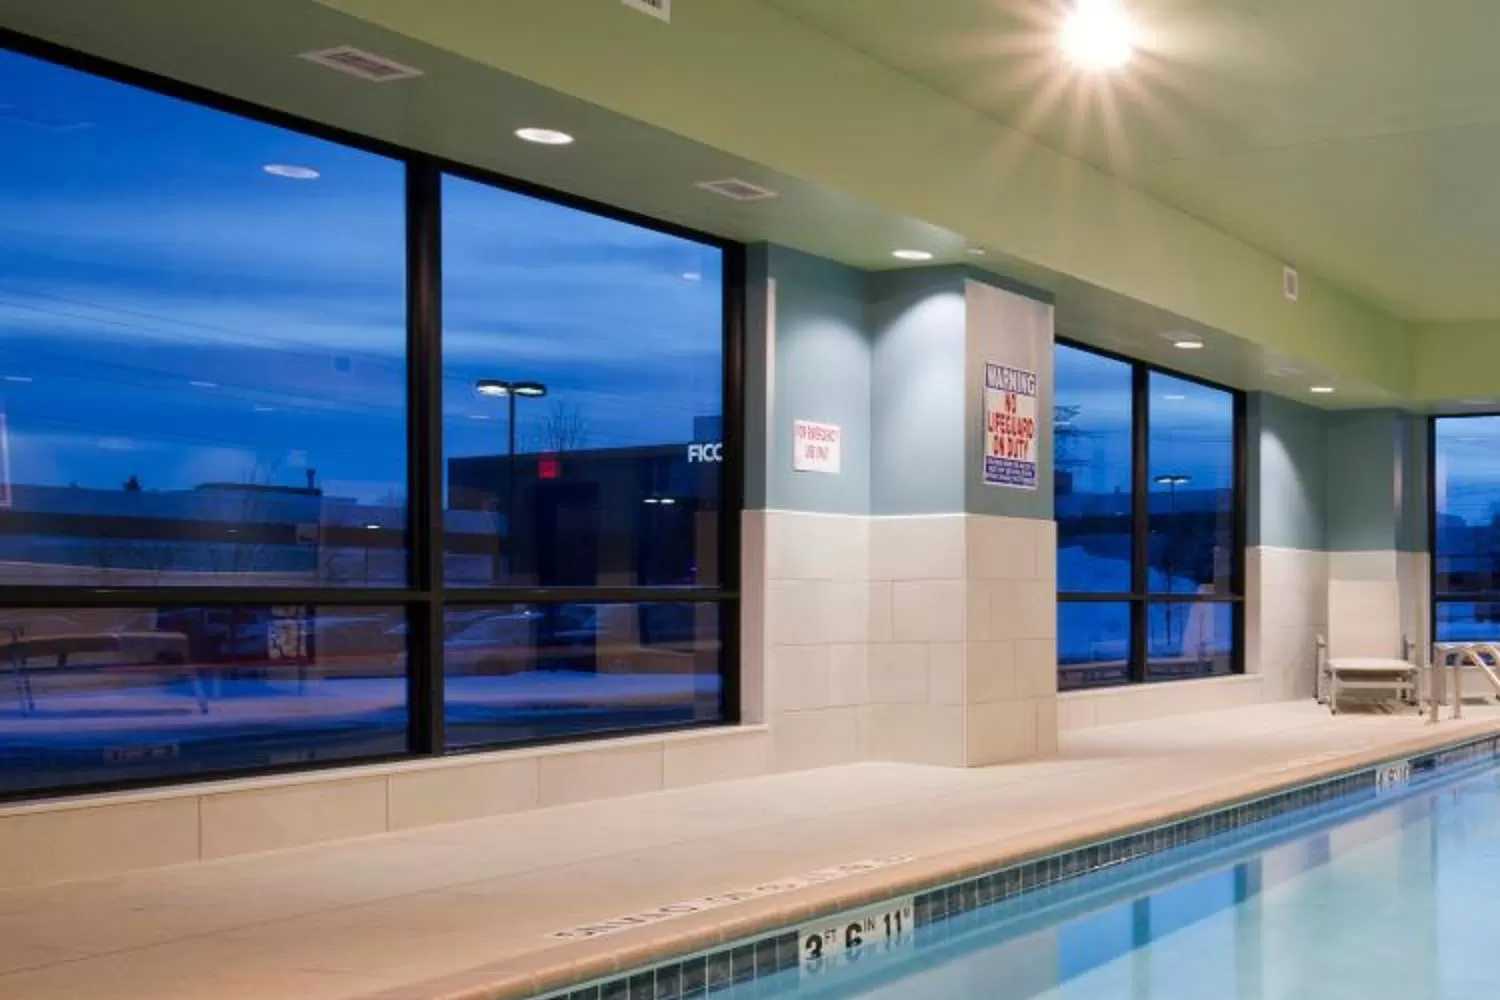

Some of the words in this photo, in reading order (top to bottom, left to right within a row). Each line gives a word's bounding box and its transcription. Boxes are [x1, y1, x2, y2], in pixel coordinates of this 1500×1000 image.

[987, 365, 1036, 396] WARNING
[1004, 393, 1017, 414] NO
[987, 410, 1034, 440] LIFEGUARD
[992, 434, 1006, 456] ON
[1006, 437, 1030, 461] DUTY
